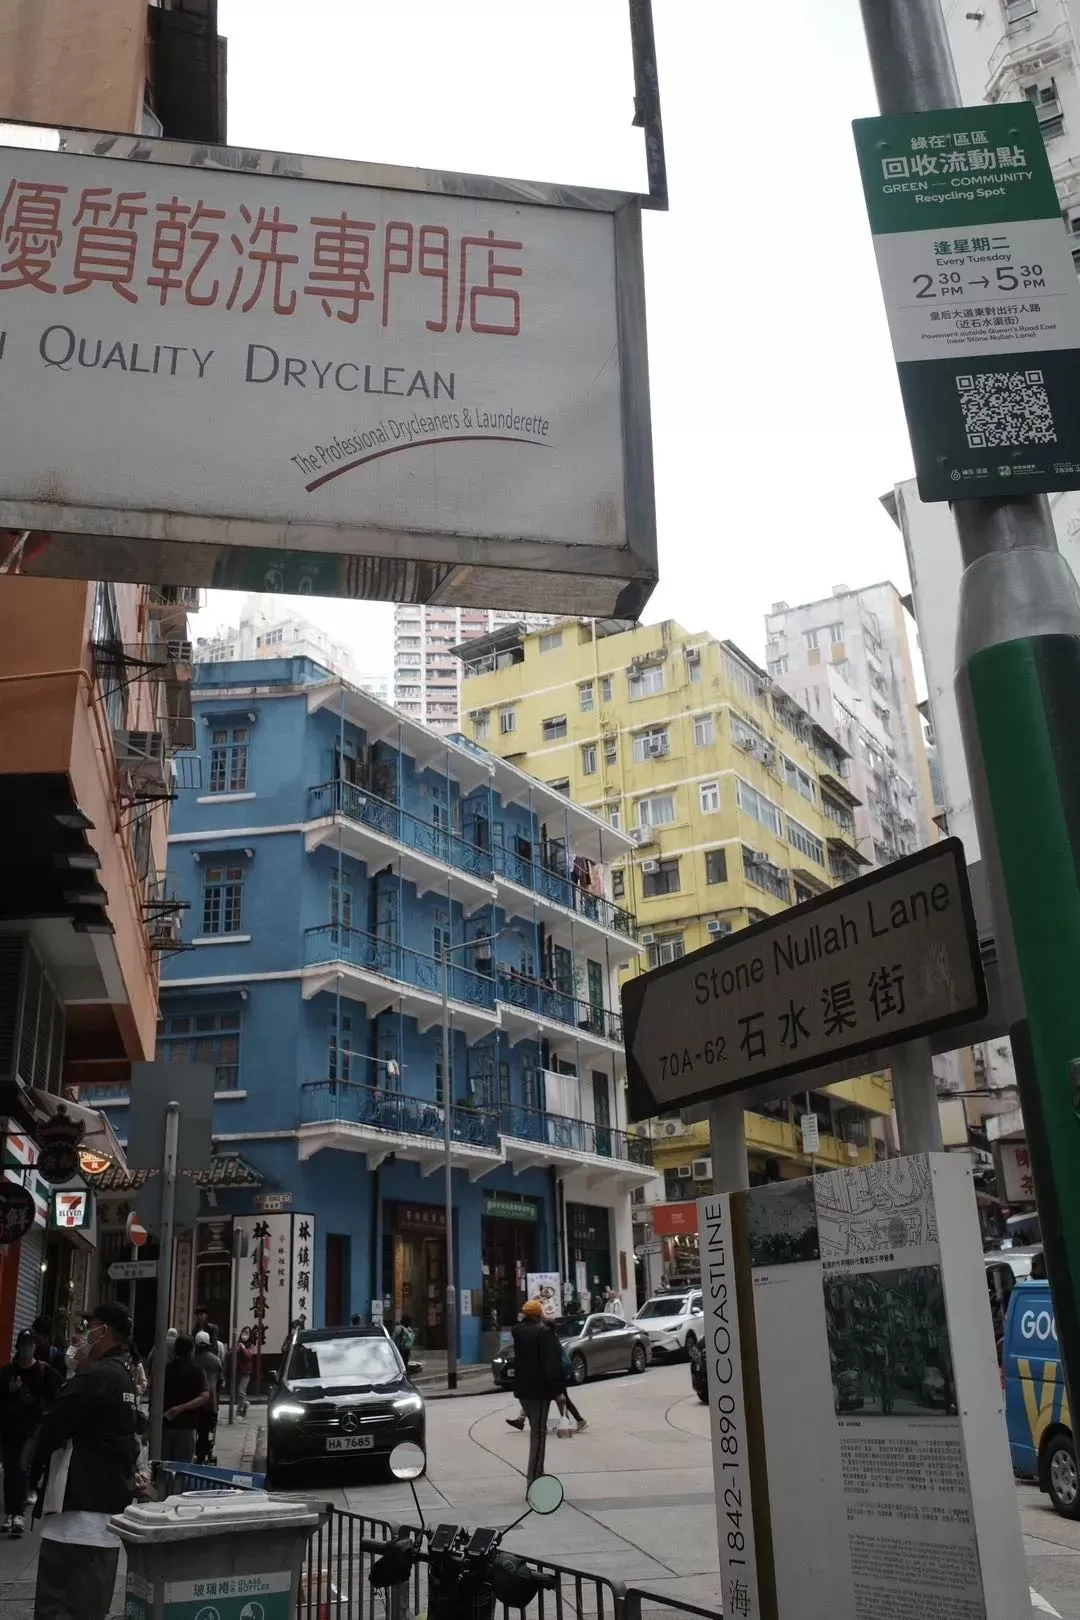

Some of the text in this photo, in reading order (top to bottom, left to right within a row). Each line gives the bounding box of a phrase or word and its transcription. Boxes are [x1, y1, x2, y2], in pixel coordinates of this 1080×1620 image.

[881, 145, 1027, 180] 回收流動點
[882, 171, 1033, 194] GREEN COMMUNITY
[915, 187, 1006, 203] Recycling Spot
[0, 178, 524, 336] 優質乾洗專門店
[934, 236, 1010, 256] 逢星期二
[936, 253, 1011, 267] Every Tuesday
[912, 264, 1046, 299] 2 30 PM 5 30 PM
[930, 303, 1041, 321] 皇后大道東對出行人路
[921, 331, 959, 340] Pavement
[960, 328, 987, 336] outside
[988, 326, 1018, 335] Queen's
[946, 337, 966, 345] (near
[989, 333, 1014, 341] Nullah
[39, 324, 214, 379] QUALITY
[245, 344, 457, 400] DRYCLEAN
[291, 408, 550, 477] The Professional Drycleaners & Launderette
[694, 881, 950, 1005] Stone Nullah Lane
[738, 964, 906, 1061] 石水渠街
[659, 1036, 728, 1081] 70A-62
[705, 1203, 747, 1569] 1842-1890 COASTLINE
[329, 1437, 371, 1449] HA 7685
[238, 1578, 262, 1586] GLASS
[238, 1583, 271, 1593] BOTTLES
